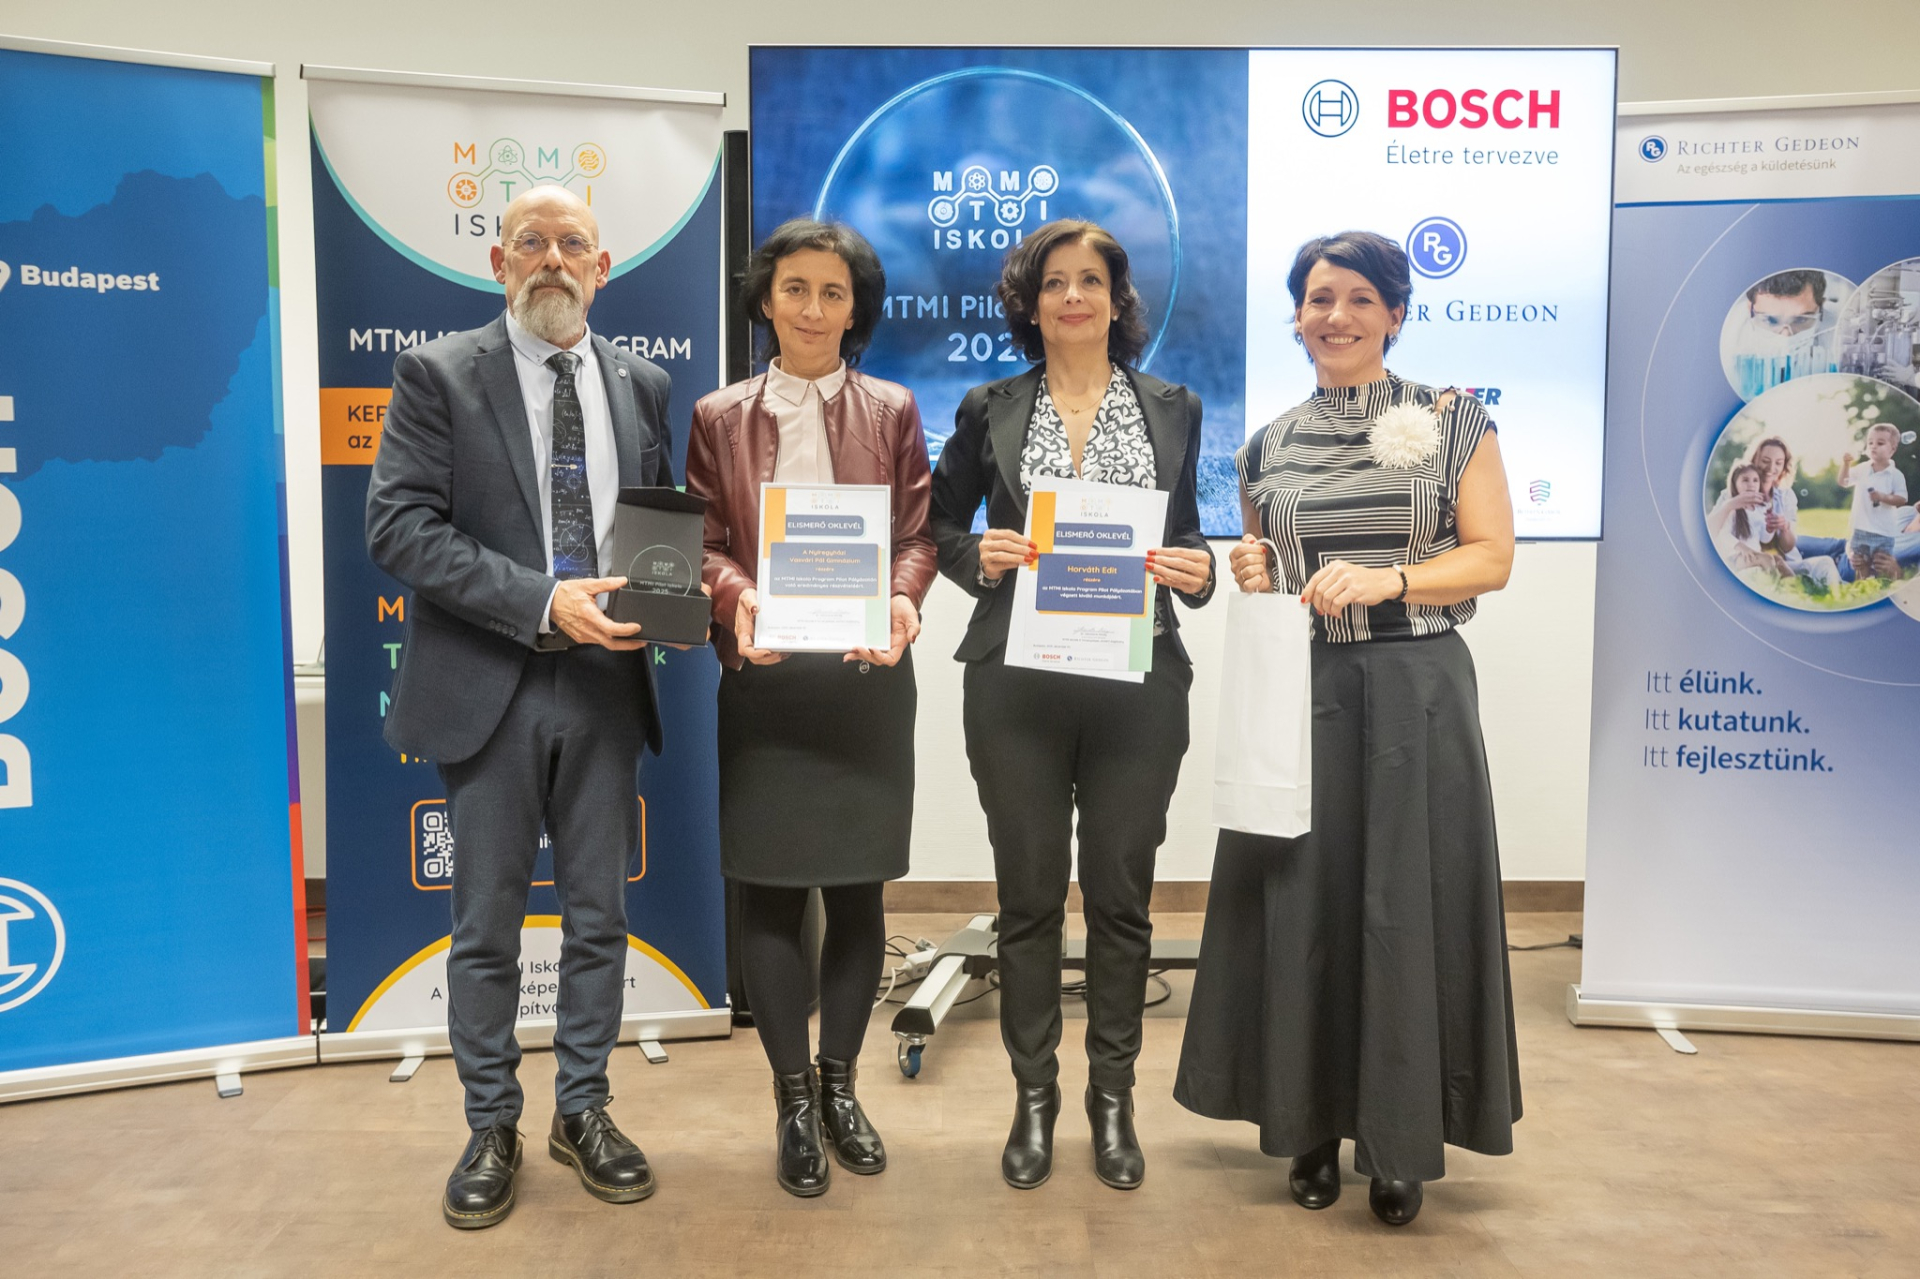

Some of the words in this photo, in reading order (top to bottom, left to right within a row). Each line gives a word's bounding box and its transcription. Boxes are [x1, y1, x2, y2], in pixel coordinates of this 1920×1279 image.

[1388, 88, 1560, 129] BOSCH
[1387, 139, 1453, 164] Életre
[1463, 147, 1559, 164] tervezve
[1678, 140, 1764, 156] RICHTER
[1775, 136, 1860, 152] GEDEON
[1677, 163, 1691, 174] Az
[1694, 161, 1748, 176] egészség
[1751, 163, 1758, 171] a
[1761, 158, 1836, 172] küldetésünk
[934, 229, 1024, 250] ISKOL
[20, 264, 160, 293] Budapest
[1446, 300, 1558, 322] GEDEON
[947, 332, 1027, 362] 202
[348, 435, 373, 449] az
[787, 521, 826, 529] ELISMERŐ
[827, 521, 862, 530] OKLEVÉL
[1055, 530, 1095, 539] ELISMERŐ
[1096, 531, 1132, 541] OKLEVÉL
[1067, 565, 1100, 574] Horváth
[1102, 566, 1118, 575] Edit
[1647, 670, 1672, 693] Itt
[1679, 669, 1762, 695] élünk.
[1645, 708, 1670, 730] Itt
[1678, 707, 1810, 734] kutatunk.
[1644, 745, 1669, 767] Itt
[1676, 744, 1834, 774] fejlesztünk.
